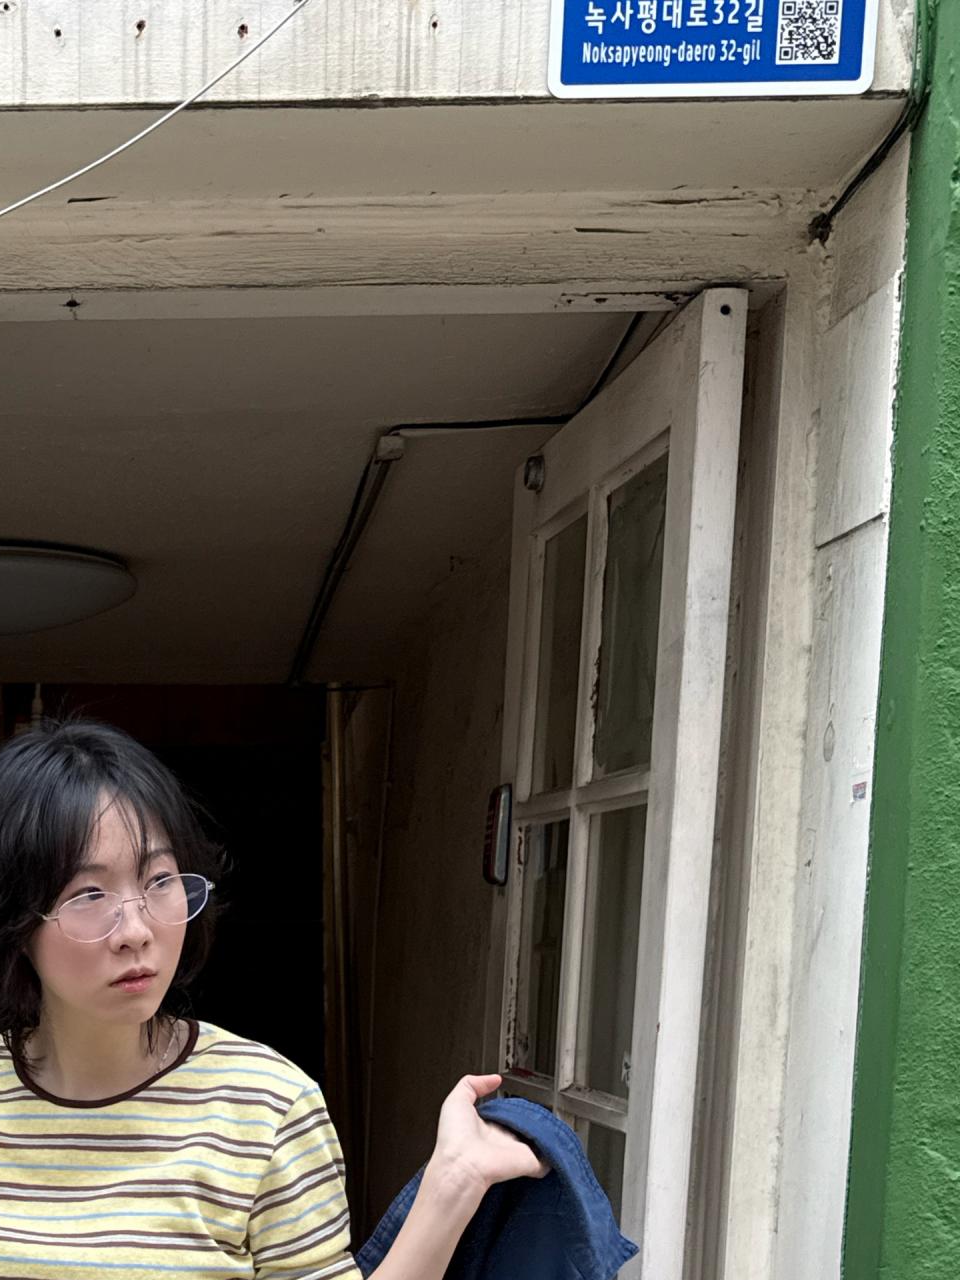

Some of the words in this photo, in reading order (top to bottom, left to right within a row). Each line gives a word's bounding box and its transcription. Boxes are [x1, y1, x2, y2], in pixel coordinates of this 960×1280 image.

[584, 0, 764, 35] 녹사평대로32길
[582, 40, 716, 67] Noksapyeong-daero
[719, 39, 761, 66] 32-gil
